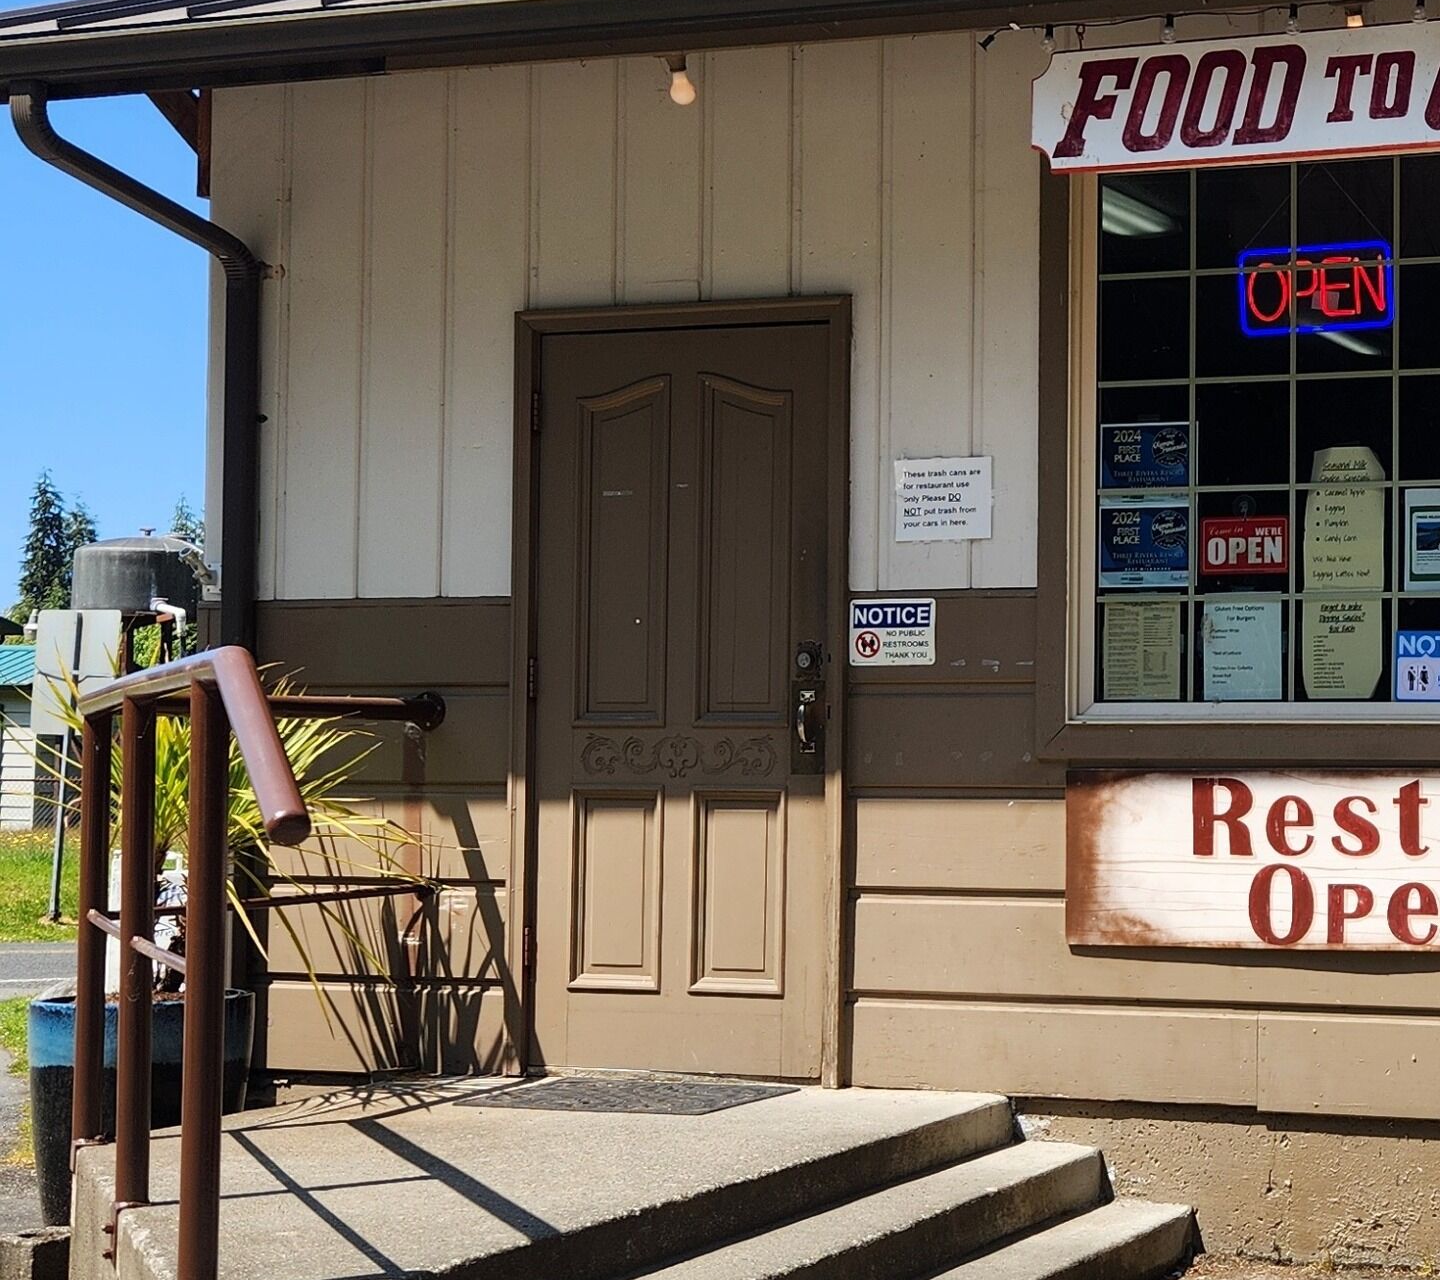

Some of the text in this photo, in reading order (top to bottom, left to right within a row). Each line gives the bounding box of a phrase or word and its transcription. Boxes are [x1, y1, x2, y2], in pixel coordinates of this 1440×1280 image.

[1052, 44, 1307, 158] FOOD
[1325, 51, 1416, 123] TO
[1247, 253, 1386, 322] OPEN
[1113, 430, 1142, 443] 2024
[1118, 445, 1142, 454] FIRST
[1113, 454, 1141, 463] PLACE
[927, 469, 947, 477] trash
[903, 493, 962, 504] only Please DO
[903, 507, 921, 517] NOT
[923, 508, 936, 516] put
[1112, 511, 1140, 525] 2024
[903, 521, 920, 529] your
[1117, 527, 1140, 536] FIRST
[1113, 536, 1140, 545] PLACE
[1207, 536, 1283, 566] OPEN
[854, 606, 930, 625] NOTICE
[882, 640, 929, 648] RESTROOMS
